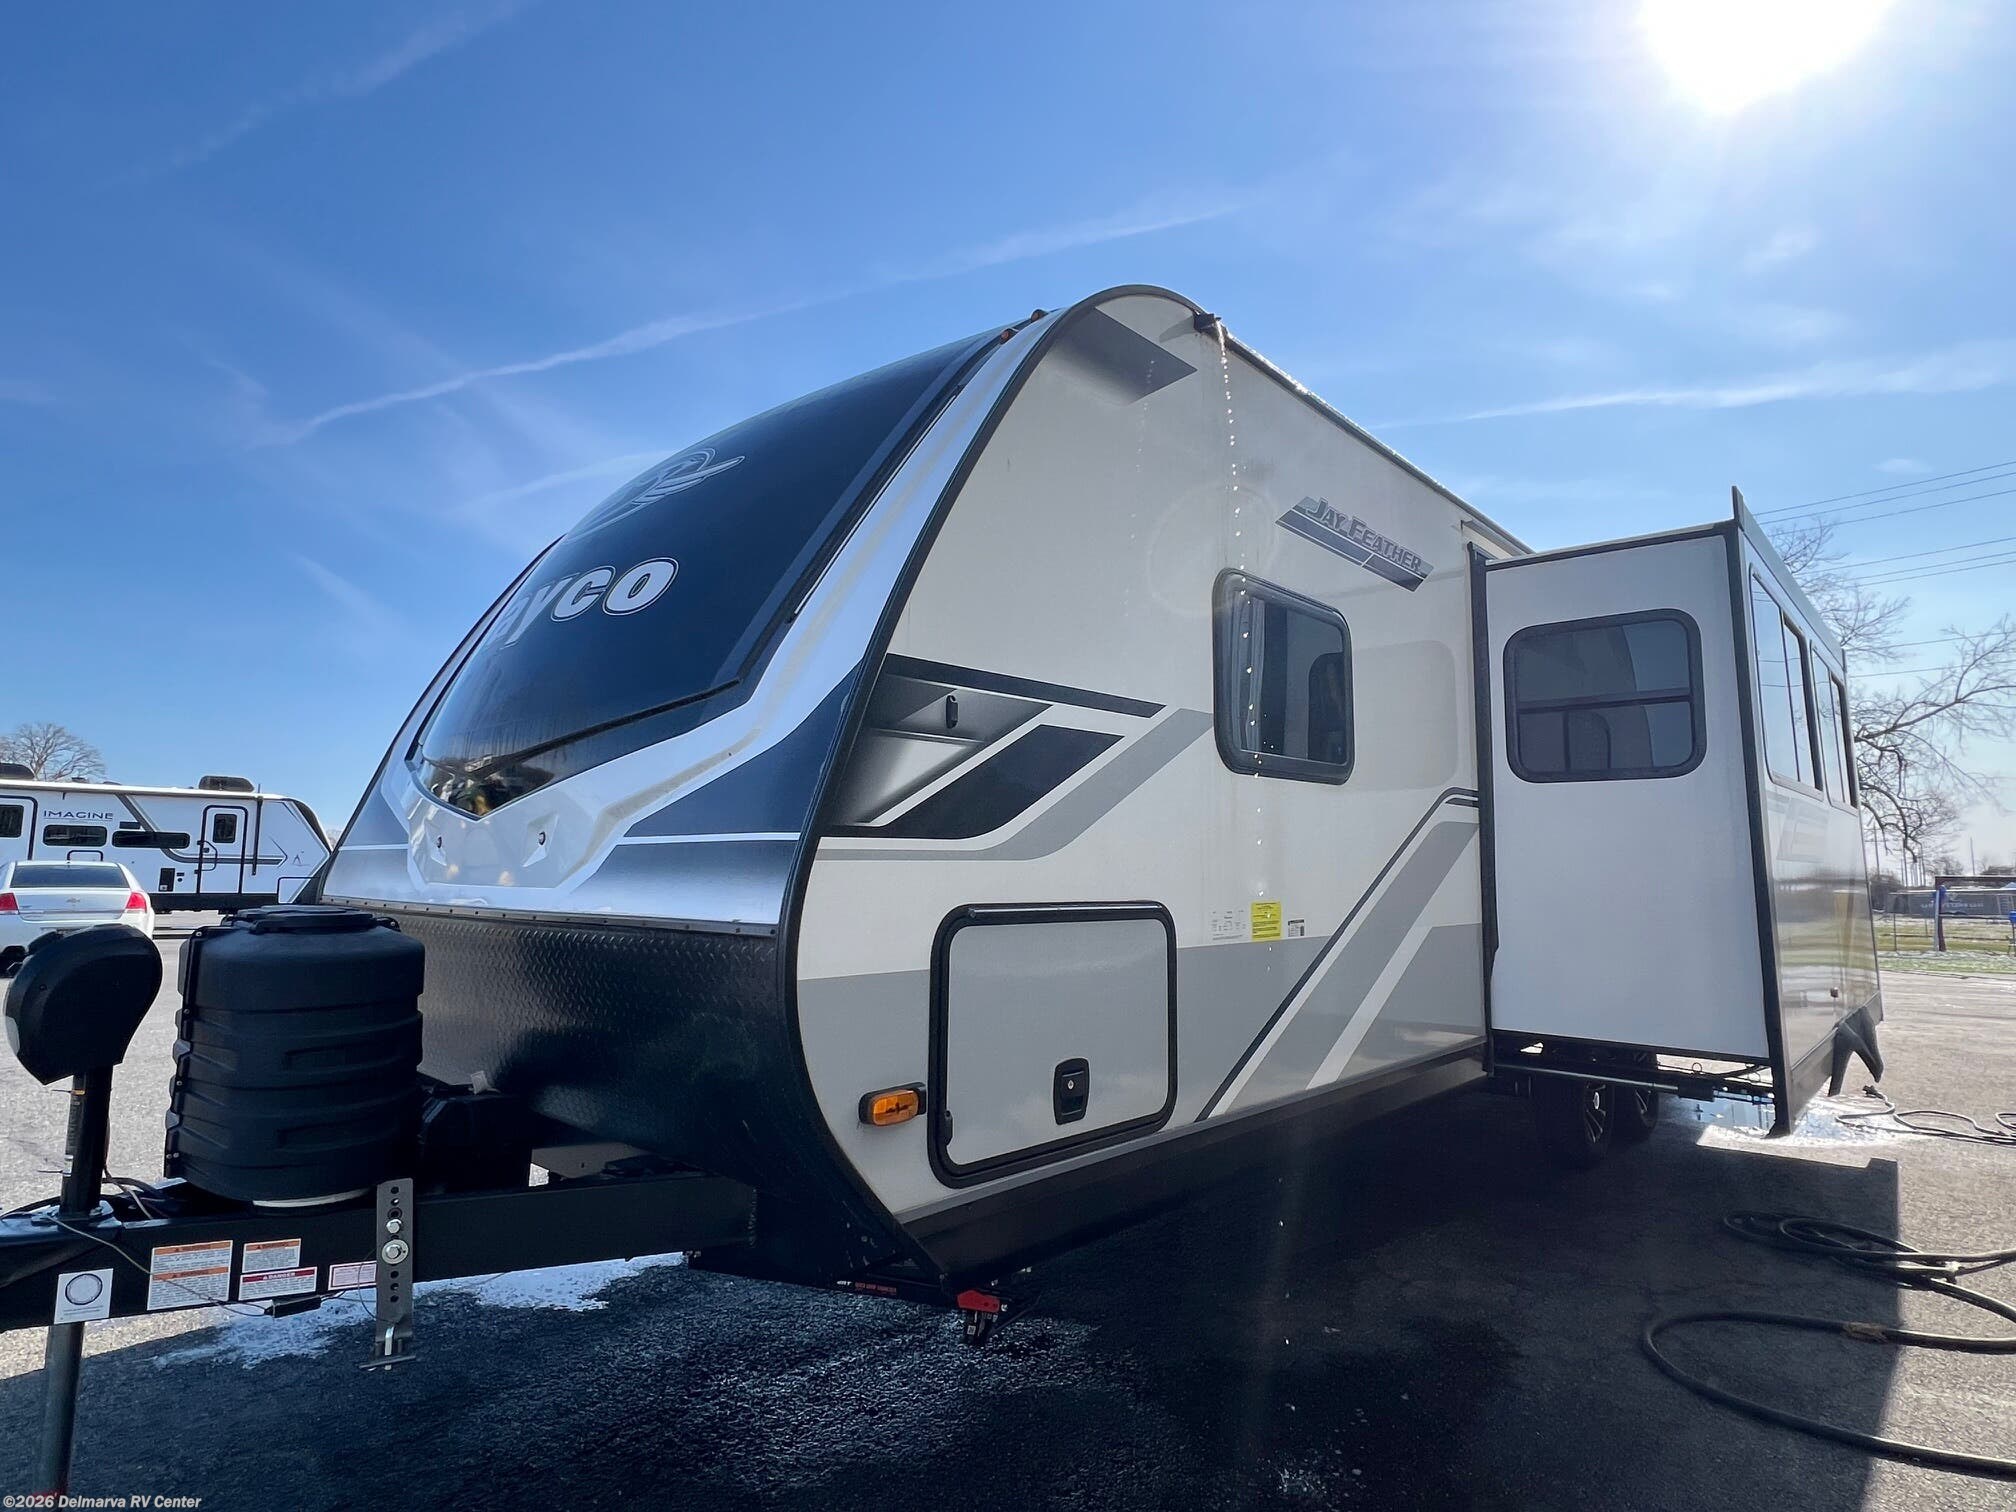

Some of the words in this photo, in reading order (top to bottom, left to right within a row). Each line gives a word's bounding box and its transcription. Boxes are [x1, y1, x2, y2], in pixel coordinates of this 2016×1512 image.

[1307, 498, 1349, 531] JAY
[1348, 516, 1423, 573] FEATHER
[43, 810, 114, 820] IMAGINE
